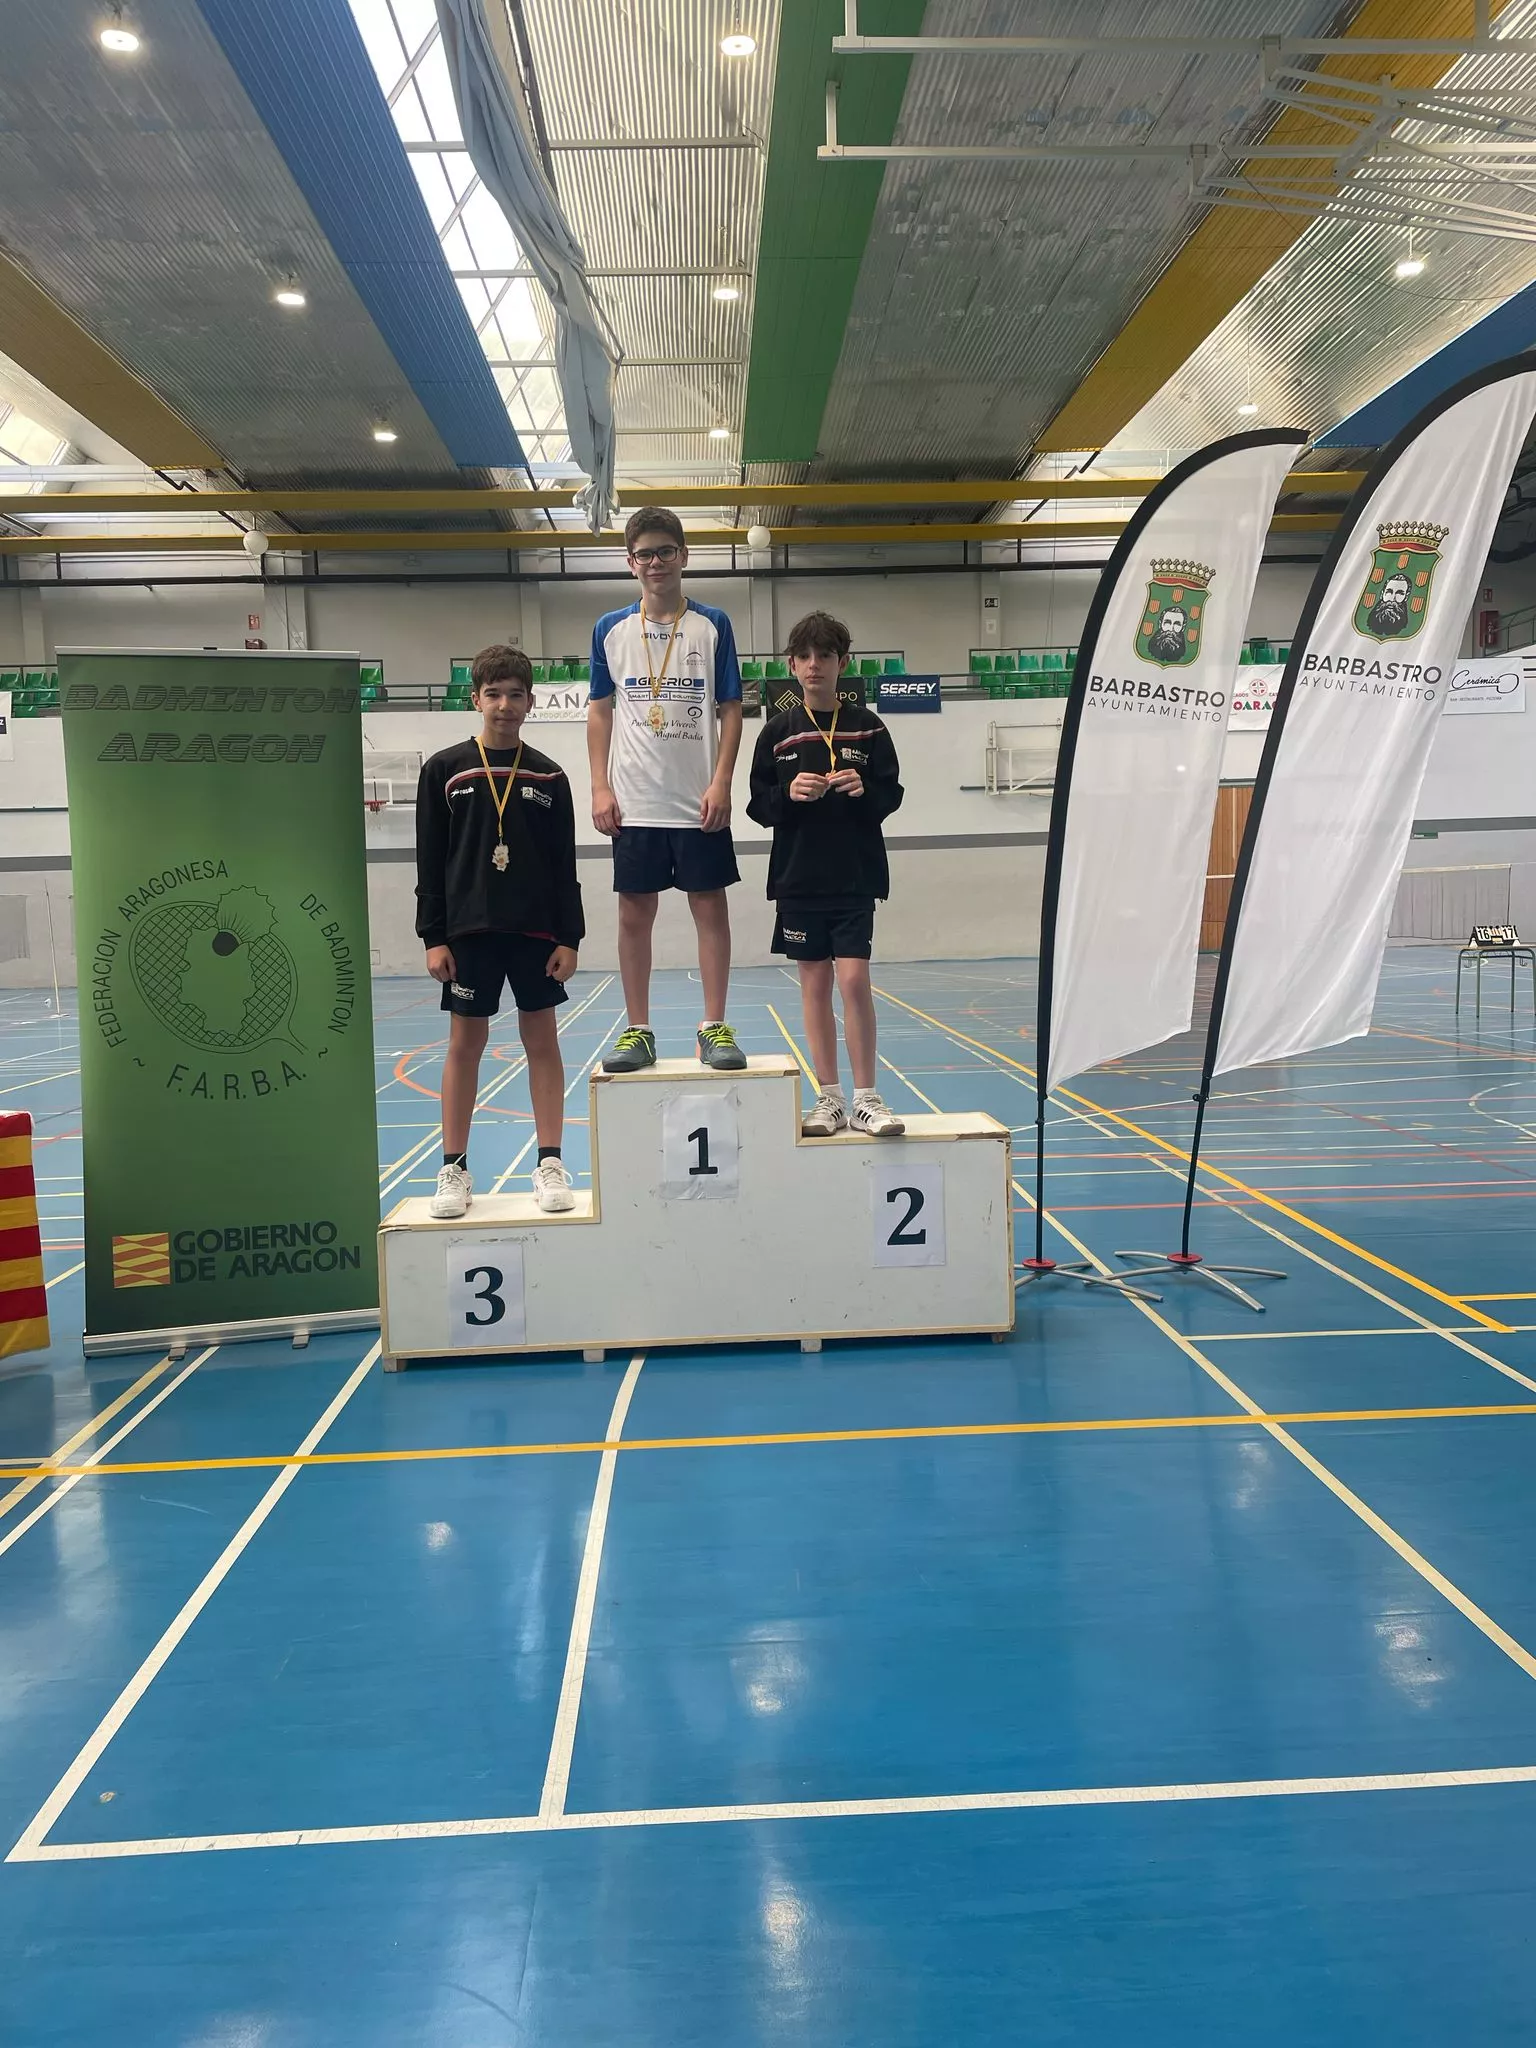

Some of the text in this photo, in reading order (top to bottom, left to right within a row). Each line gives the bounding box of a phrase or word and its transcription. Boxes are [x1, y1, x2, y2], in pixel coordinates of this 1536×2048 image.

[1303, 654, 1442, 684] BARBASTRO
[64, 684, 357, 713] BADMINTON
[880, 682, 937, 694] SERFEY
[1090, 675, 1226, 708] BARBASTRO
[1300, 675, 1435, 701] AYUNTAMIENTO
[1087, 697, 1222, 723] AYUNTAMIENTO
[97, 733, 326, 762] ARAGON
[1478, 928, 1489, 939] 16
[1503, 928, 1514, 938] 17
[92, 860, 356, 1048] FEDERACION ARAGONESA DE BADMINTON
[687, 1127, 718, 1176] 1
[886, 1186, 927, 1246] 2
[173, 1220, 338, 1255] GOBIERNO
[174, 1246, 361, 1284] DE ARAGON
[464, 1266, 506, 1326] 3
